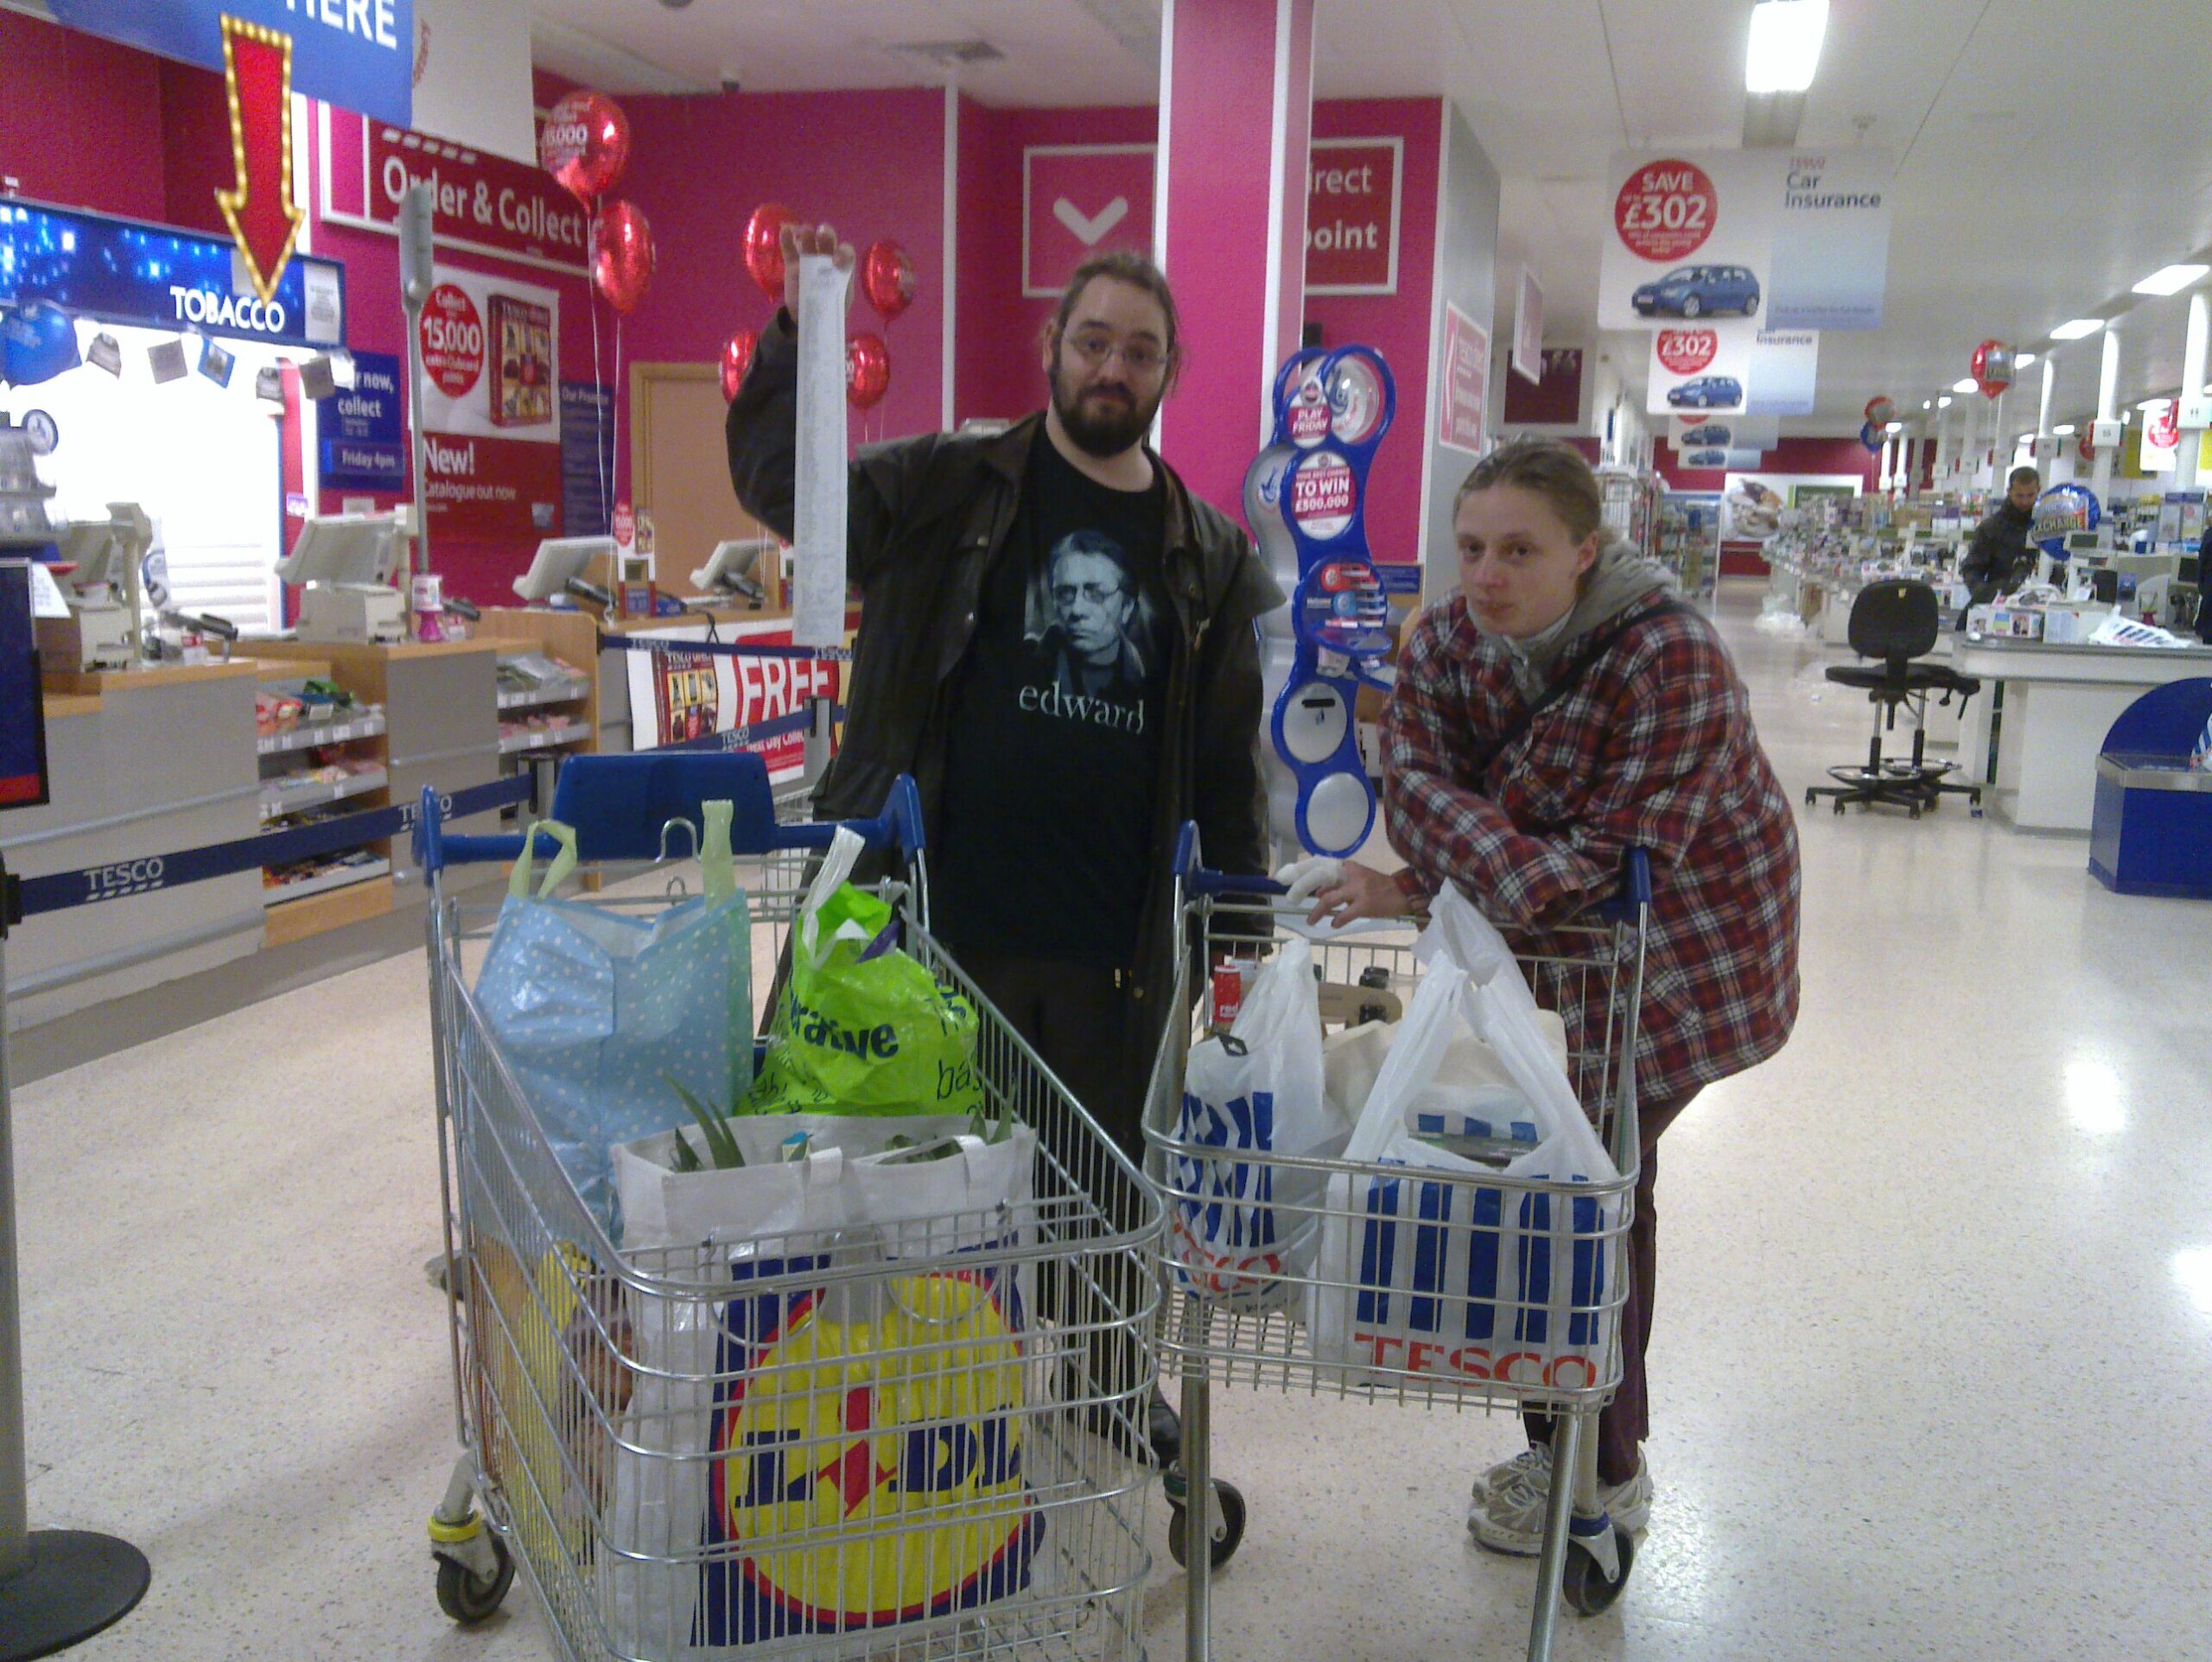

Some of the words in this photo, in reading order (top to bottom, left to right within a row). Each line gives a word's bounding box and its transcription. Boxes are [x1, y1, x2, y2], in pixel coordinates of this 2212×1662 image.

[1643, 172, 1694, 192] SAVE
[1786, 172, 1821, 189] Car
[1784, 190, 1881, 208] Insurance
[474, 180, 493, 226] &
[499, 187, 583, 247] Collect
[1623, 193, 1707, 229] £302
[169, 286, 285, 333] TOBACCO
[423, 316, 481, 356] 15,000
[1662, 337, 1712, 356] £302
[338, 396, 382, 417] collect
[1298, 406, 1323, 421] PLAY
[1293, 419, 1328, 434] FRIDAY
[342, 449, 372, 469] Friday
[424, 438, 474, 475] New!
[477, 485, 493, 500] out
[495, 487, 516, 501] now
[1296, 480, 1317, 498] TO
[1319, 476, 1350, 497] WIN
[737, 655, 829, 727] FREE
[1019, 681, 1144, 734] edward
[722, 726, 749, 745] TESCO
[398, 796, 453, 823] TEO
[84, 858, 163, 891] TESCO
[1354, 1332, 1597, 1395] TESCO
